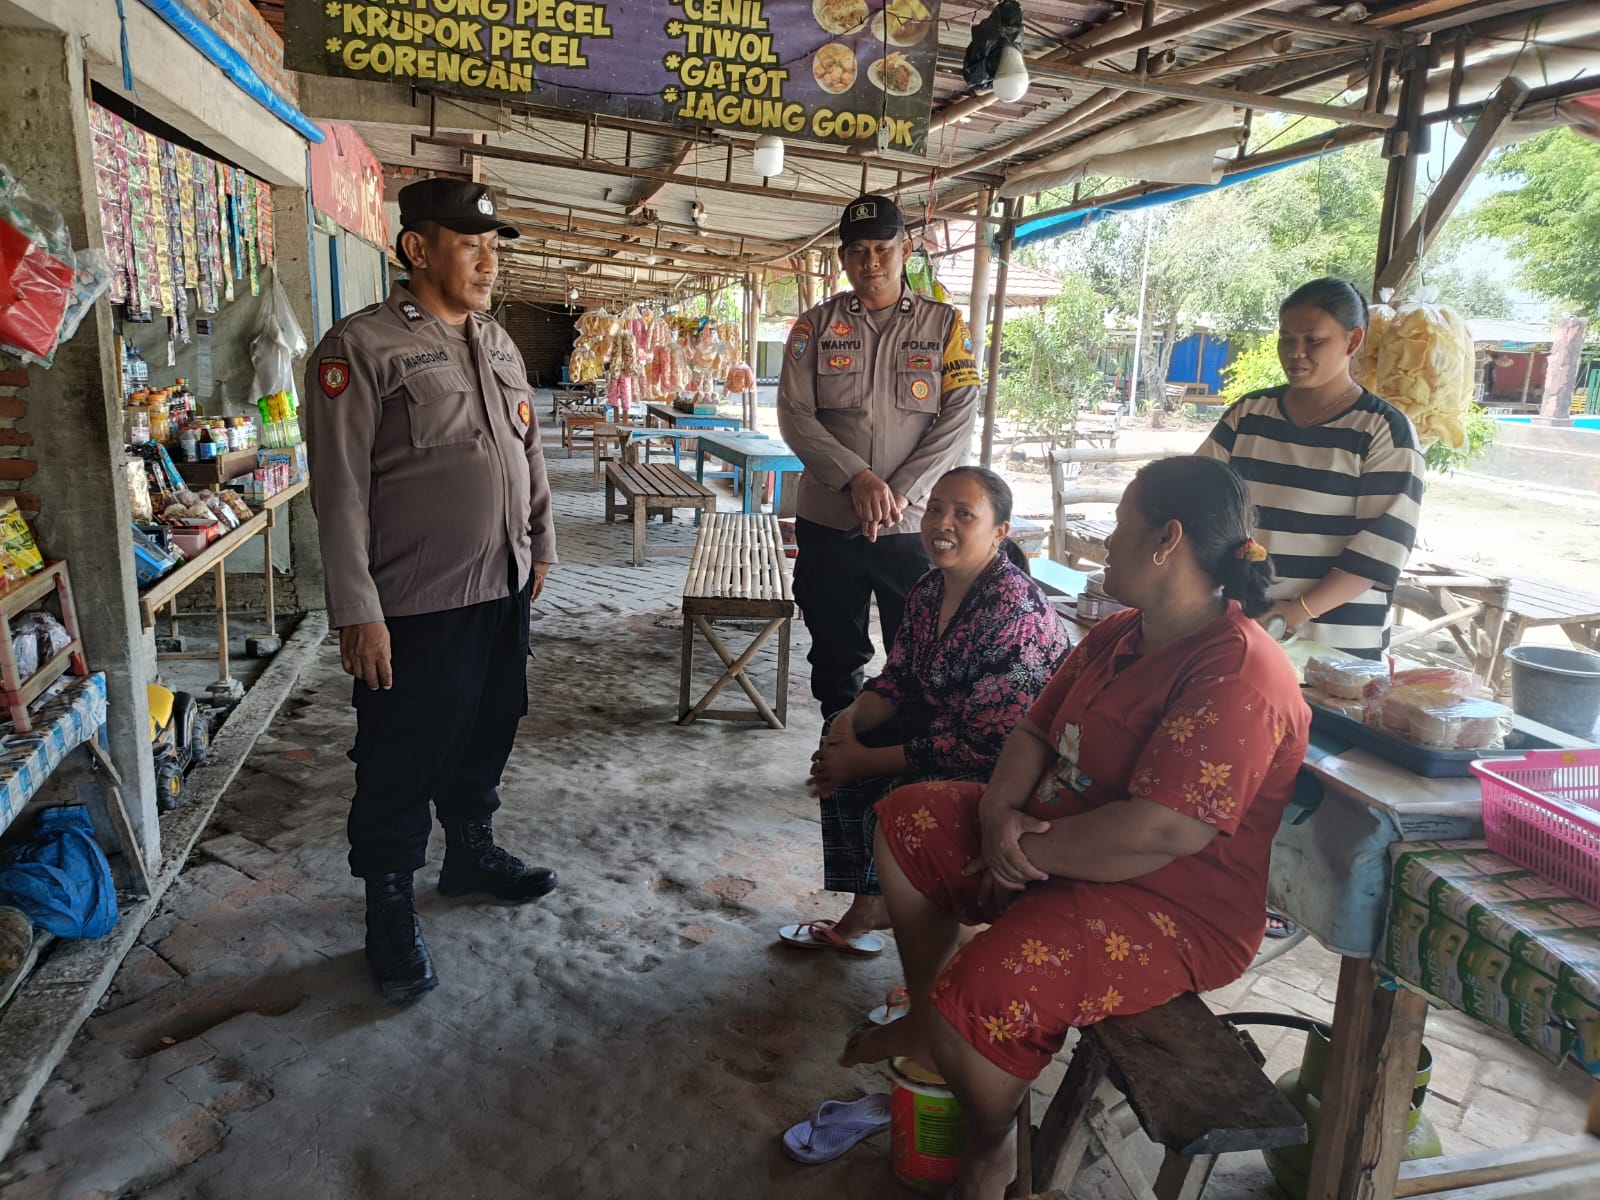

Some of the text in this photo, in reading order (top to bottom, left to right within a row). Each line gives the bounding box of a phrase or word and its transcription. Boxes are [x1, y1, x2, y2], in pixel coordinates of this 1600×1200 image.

[343, 3, 483, 53] KRUPOK
[516, 0, 611, 36] PECEL
[684, 0, 767, 29] CENIL
[491, 25, 586, 67] PECEL
[683, 24, 777, 64] TIWOL
[342, 40, 533, 92] GORENGAN
[680, 57, 787, 98] GATOT
[678, 90, 914, 147] JAGUNG GODOK
[821, 340, 861, 351] WAHYU
[901, 340, 940, 351] POLRI
